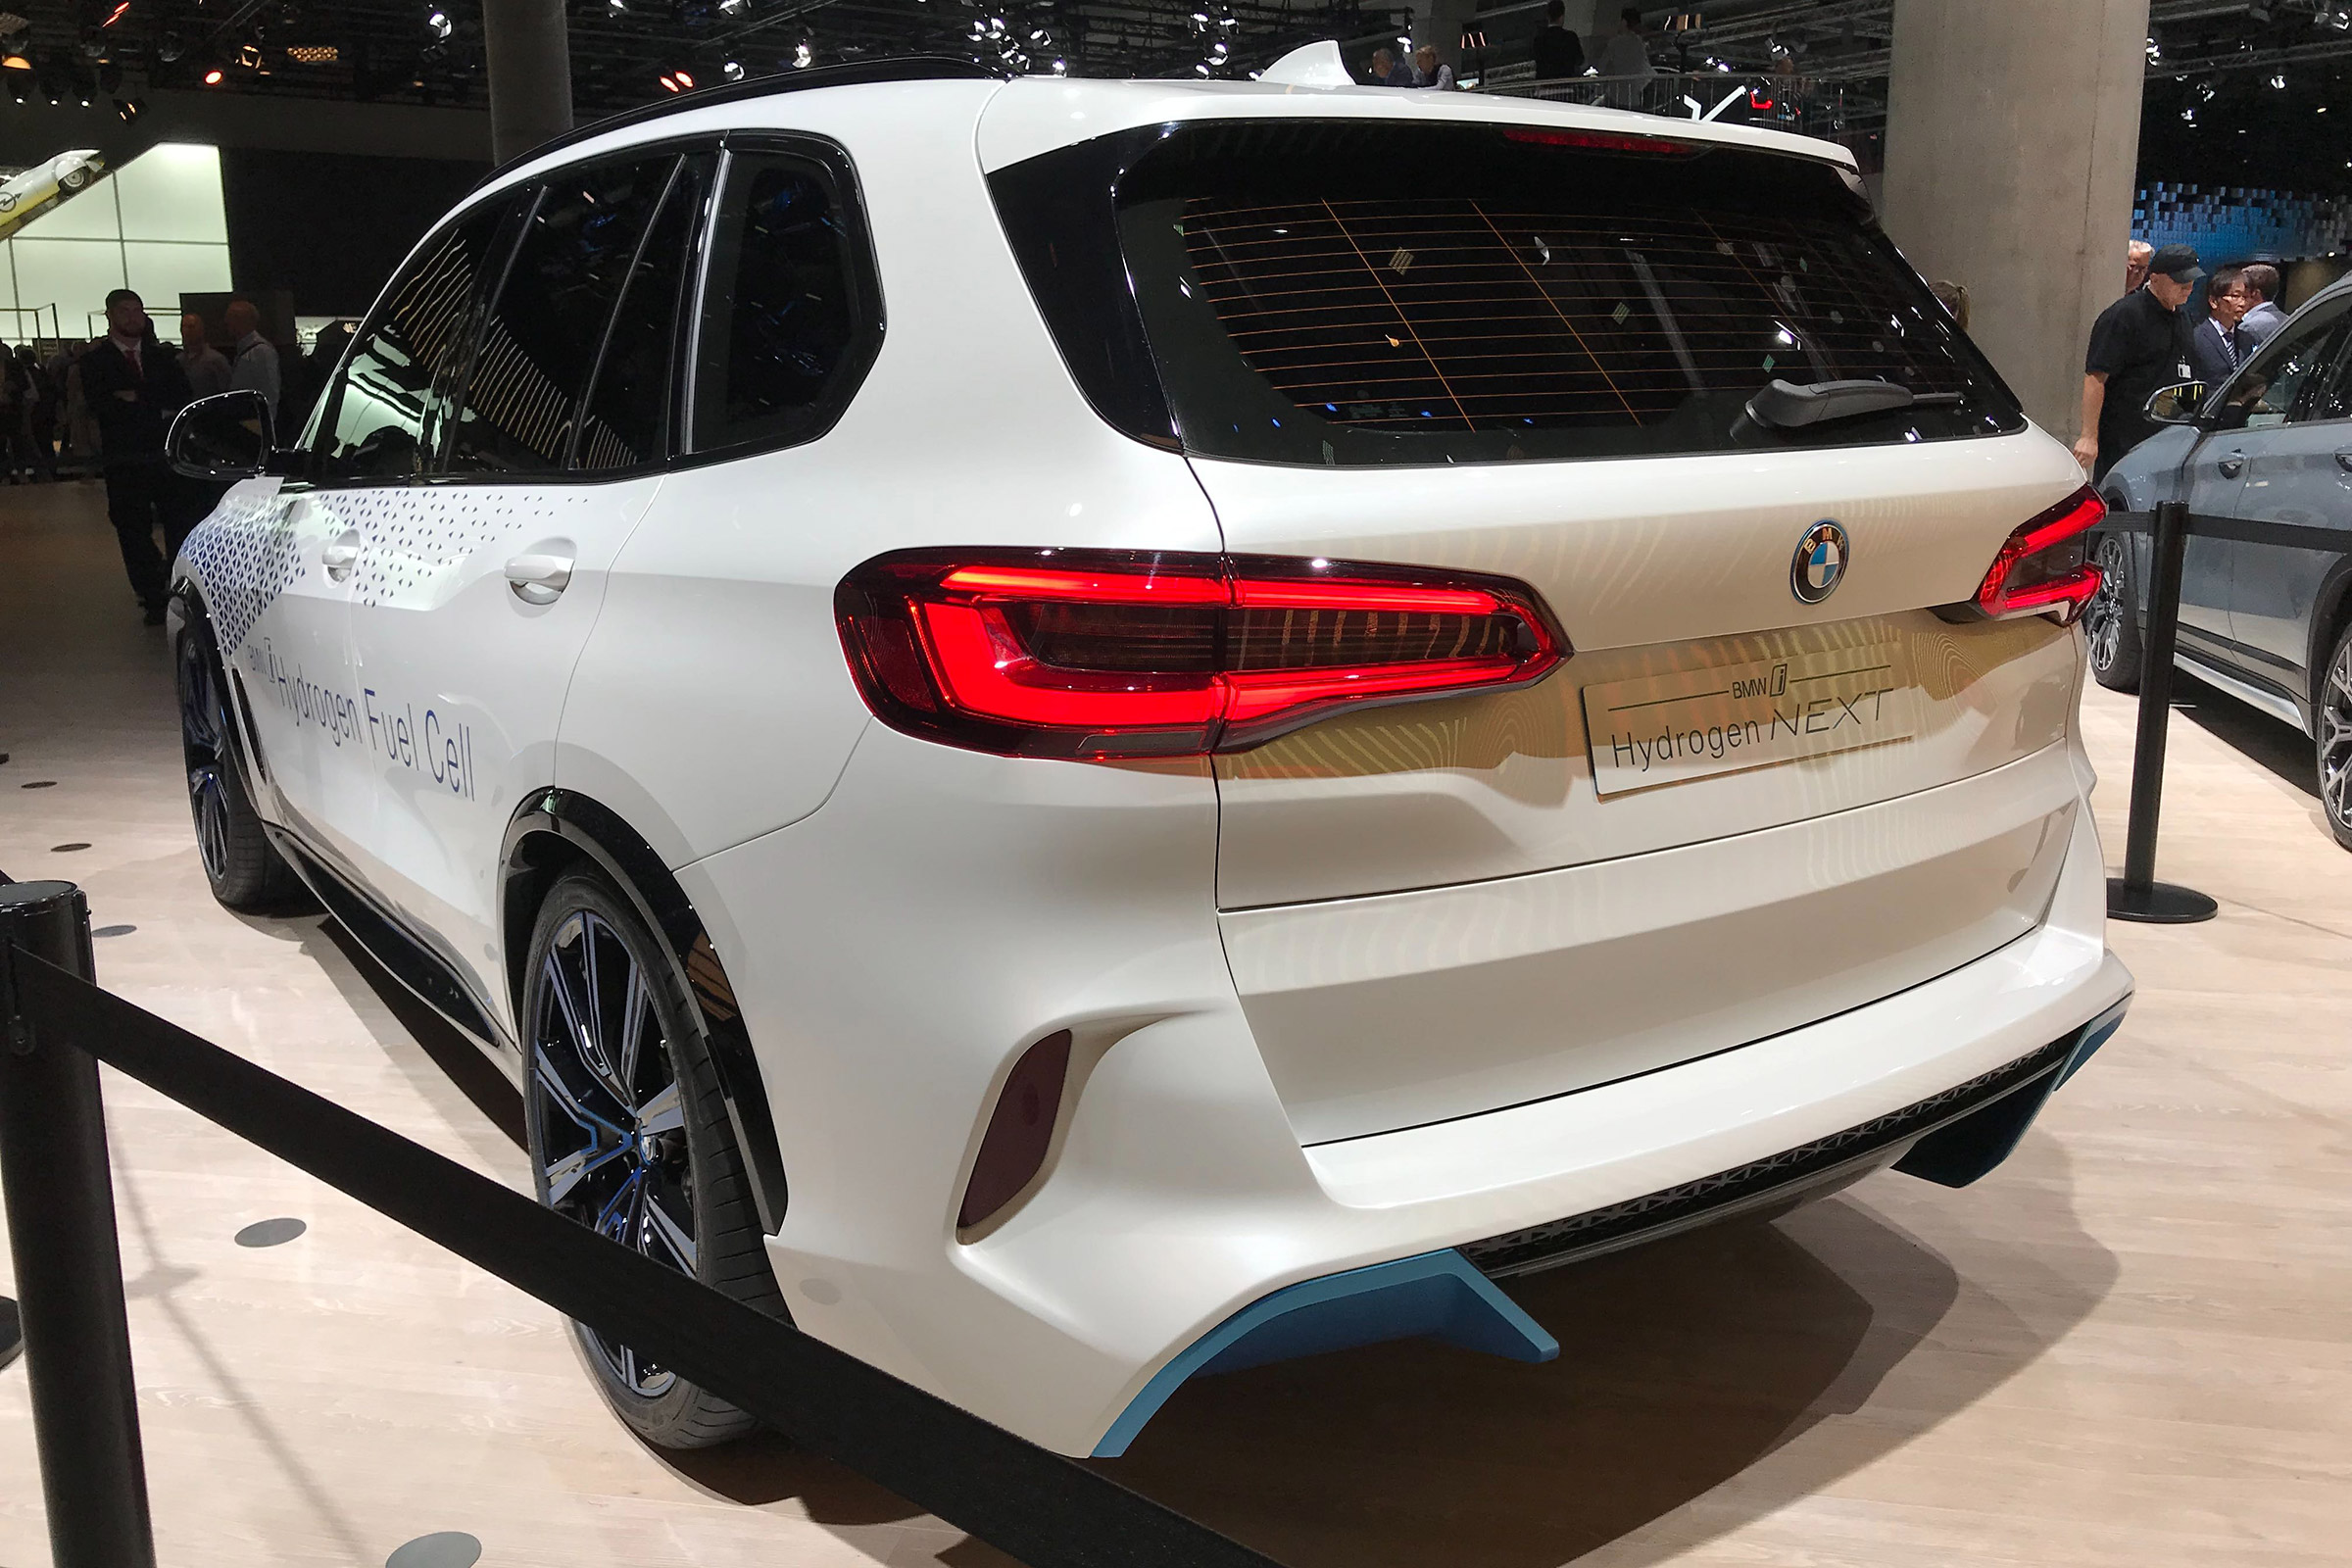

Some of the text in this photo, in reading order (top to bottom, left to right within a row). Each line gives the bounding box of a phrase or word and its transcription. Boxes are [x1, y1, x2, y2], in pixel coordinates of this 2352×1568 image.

[1803, 526, 1845, 555] BMW
[1732, 676, 1768, 701] BMW
[272, 653, 364, 748] Hydrogen
[364, 687, 419, 771] Fuel
[424, 709, 475, 802] Cell
[1611, 687, 1895, 773] Hydrogen NEXT
